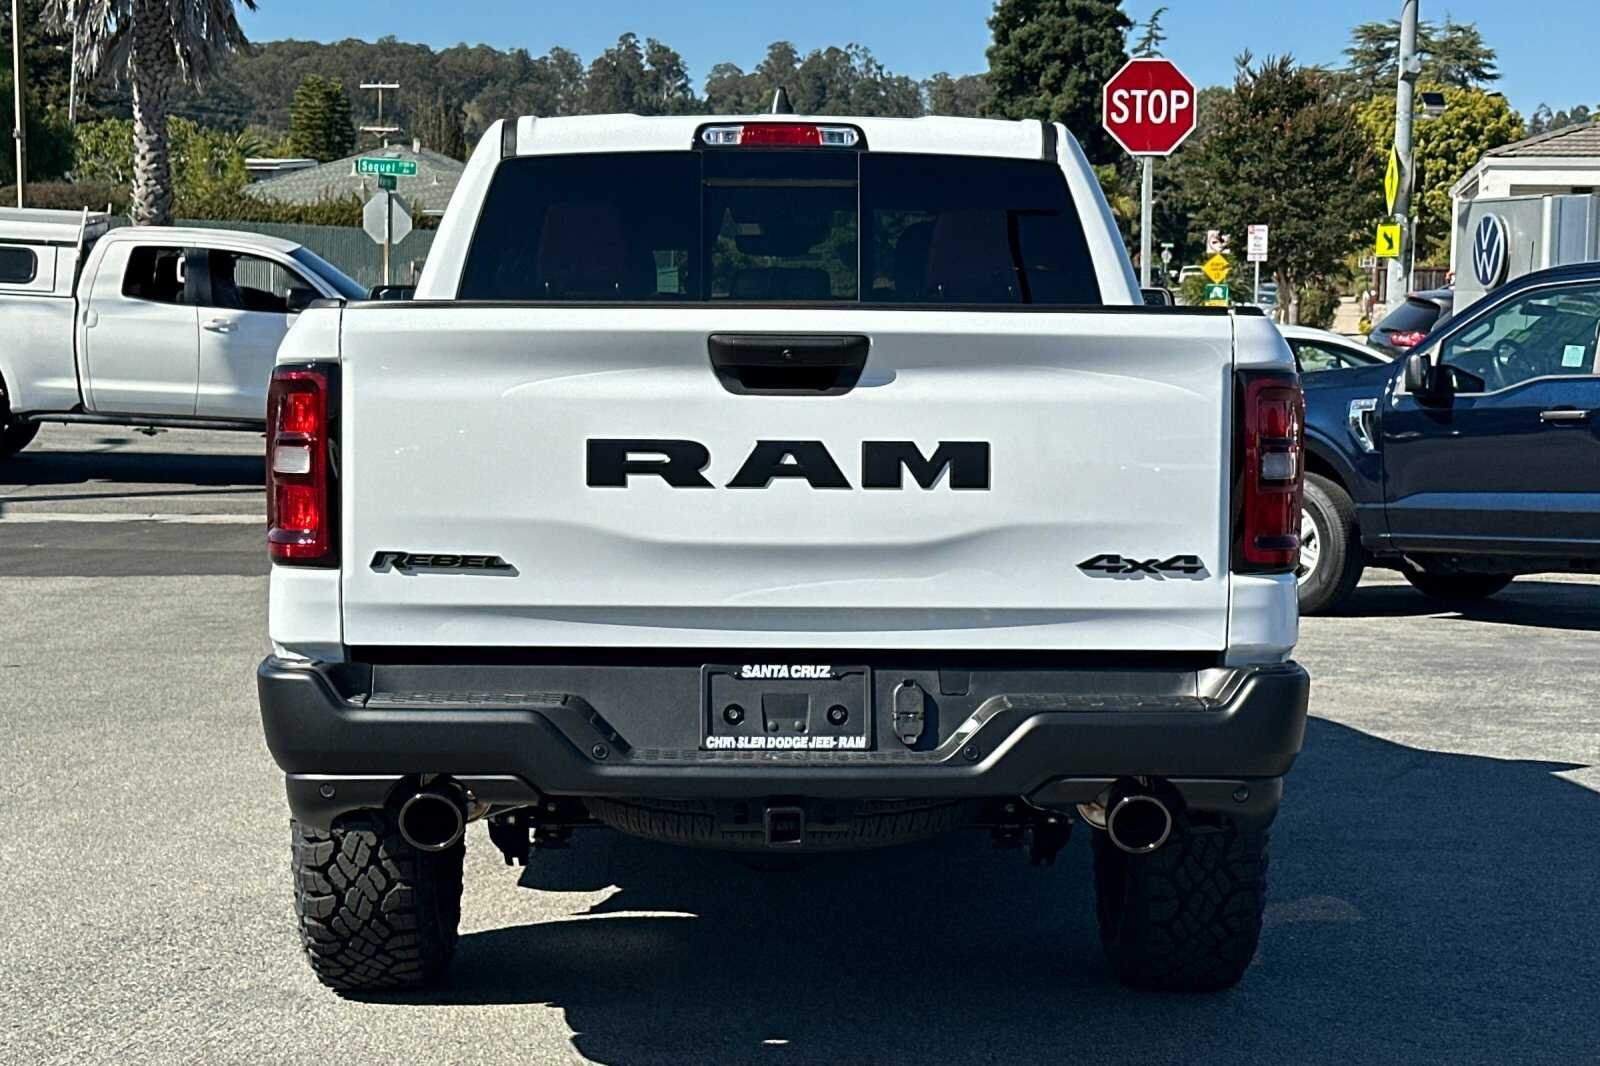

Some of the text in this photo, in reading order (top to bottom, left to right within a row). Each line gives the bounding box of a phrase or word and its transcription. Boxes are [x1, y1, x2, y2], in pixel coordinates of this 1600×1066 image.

[1110, 88, 1190, 124] STOP
[361, 160, 396, 173] Soquel
[586, 438, 991, 490] RAM
[741, 664, 831, 679] SANTA CRUZ
[766, 736, 808, 750] DODGE
[839, 736, 867, 750] RAM
